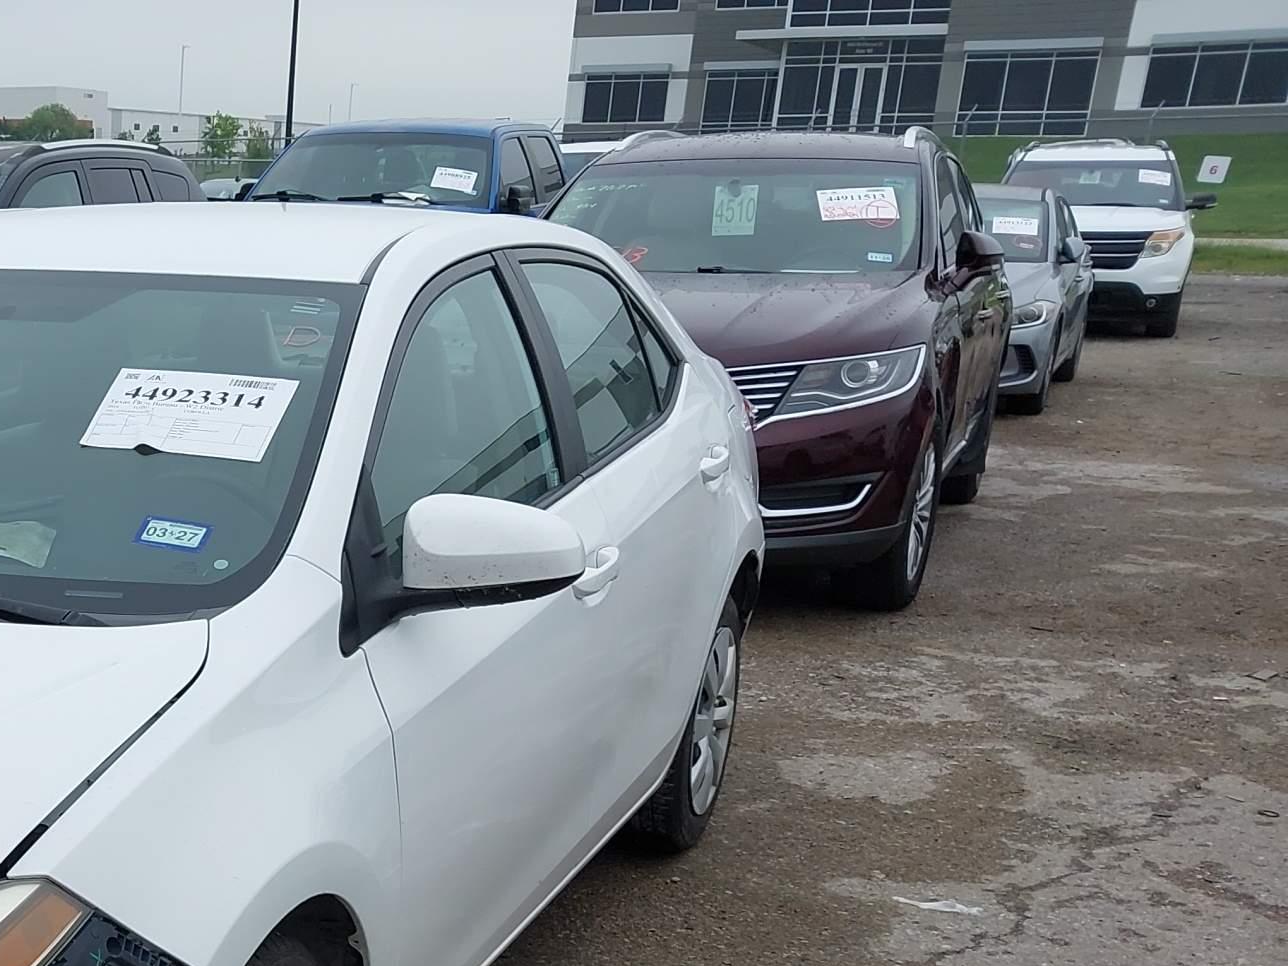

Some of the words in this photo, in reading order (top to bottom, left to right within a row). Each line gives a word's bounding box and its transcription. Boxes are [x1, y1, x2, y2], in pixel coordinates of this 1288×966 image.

[1209, 165, 1218, 175] 6
[714, 198, 755, 223] 4510
[124, 386, 266, 409] 44923314
